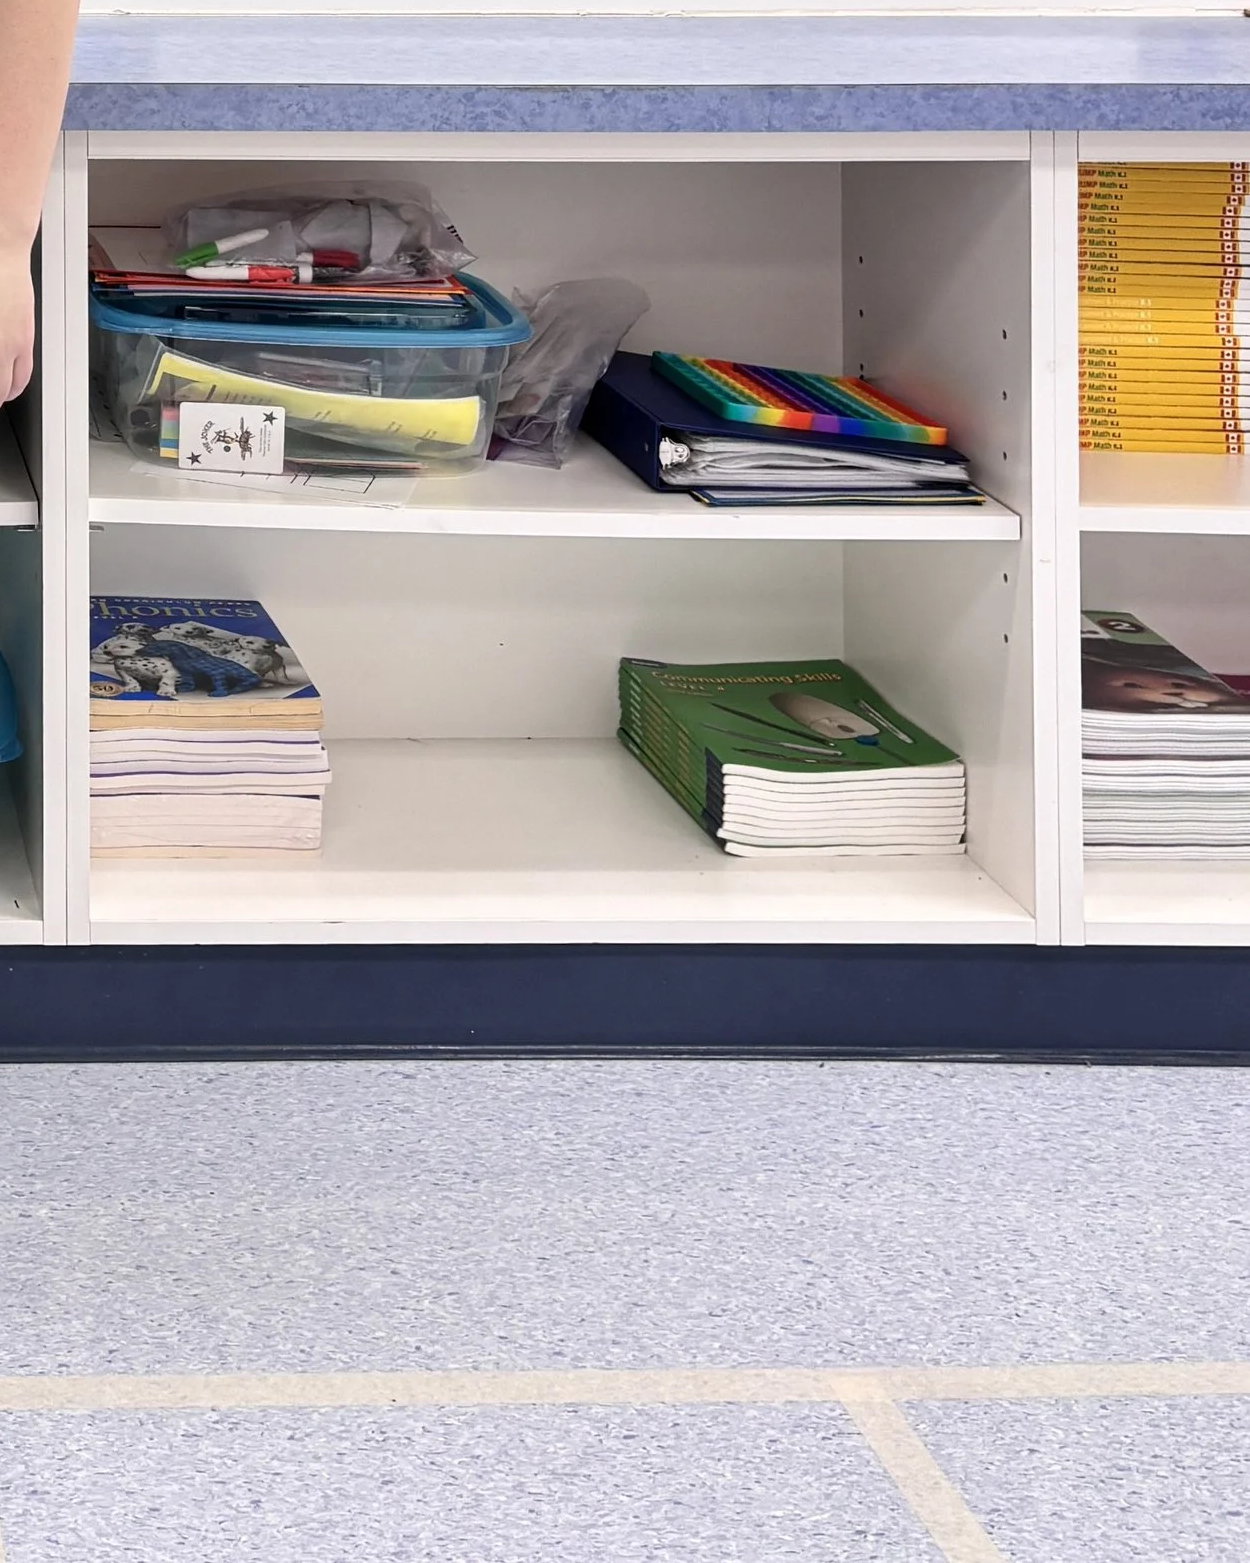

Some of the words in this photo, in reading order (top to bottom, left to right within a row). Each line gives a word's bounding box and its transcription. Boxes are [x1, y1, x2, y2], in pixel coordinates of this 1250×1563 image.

[1098, 170, 1117, 178] Math
[1090, 203, 1109, 211] Math
[1088, 215, 1107, 223] Math
[1090, 263, 1108, 271] Math
[1087, 275, 1105, 283] Math
[1087, 359, 1106, 367] Math
[1087, 394, 1105, 402] Math
[200, 420, 216, 441] JOKER
[202, 441, 214, 454] THE
[1107, 620, 1137, 632] 2
[651, 670, 794, 685] Communicating
